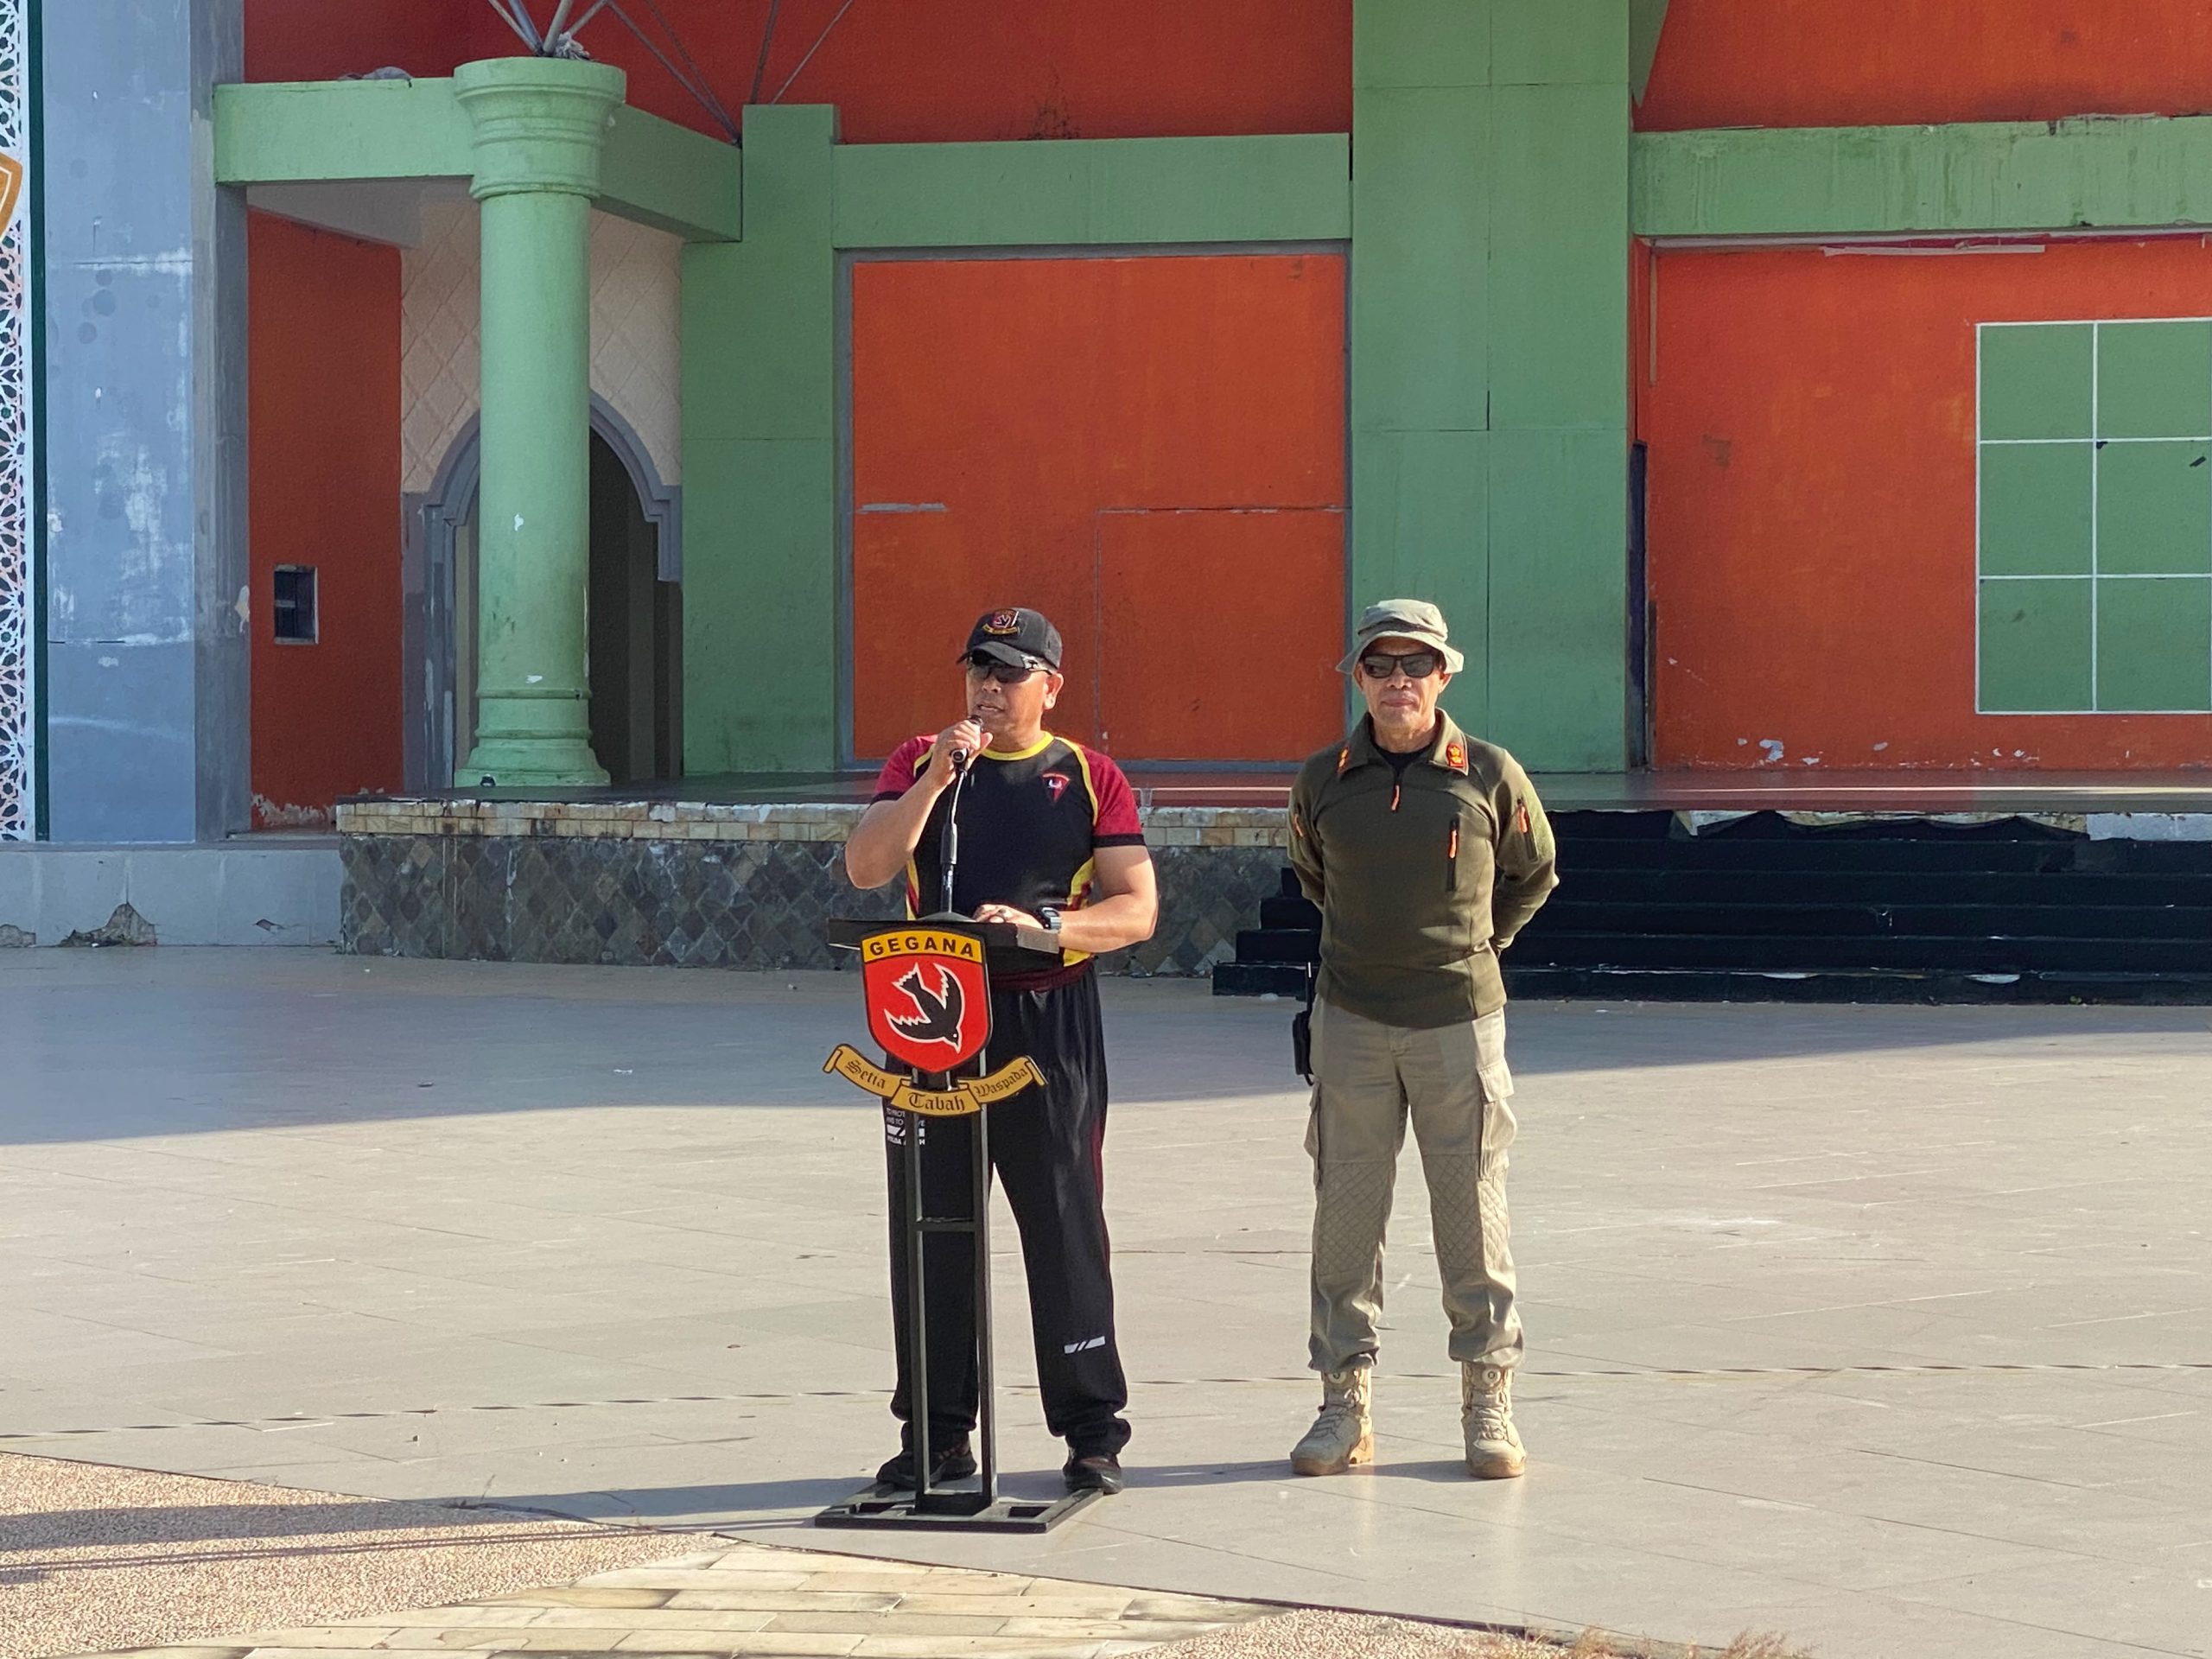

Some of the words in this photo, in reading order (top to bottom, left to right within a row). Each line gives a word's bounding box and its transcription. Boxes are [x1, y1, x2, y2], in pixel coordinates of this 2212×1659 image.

[869, 937, 974, 957] GEGANA
[846, 1059, 886, 1089] Setia
[909, 1092, 965, 1113] Tabah
[974, 1066, 1028, 1097] Waspada
